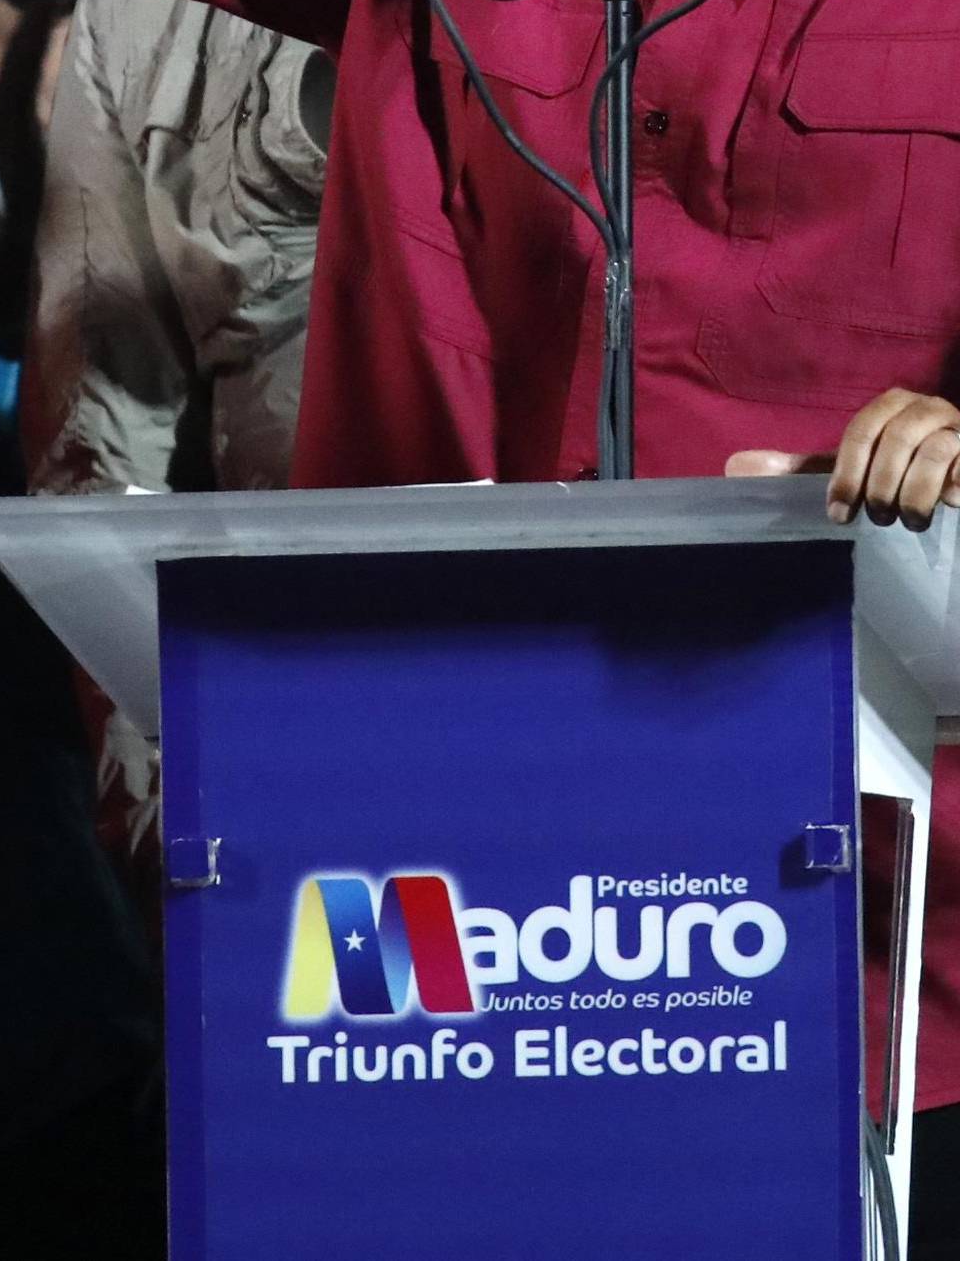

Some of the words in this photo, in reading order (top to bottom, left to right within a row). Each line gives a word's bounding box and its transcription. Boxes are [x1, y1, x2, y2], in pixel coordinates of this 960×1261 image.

[597, 872, 748, 898] Presidente
[283, 872, 787, 1018] Maduro
[480, 992, 563, 1014] Juntos
[569, 989, 627, 1010] todo
[632, 992, 660, 1008] es
[664, 985, 753, 1012] posible
[267, 1029, 494, 1083] Triunfo
[514, 1021, 787, 1077] Electoral
